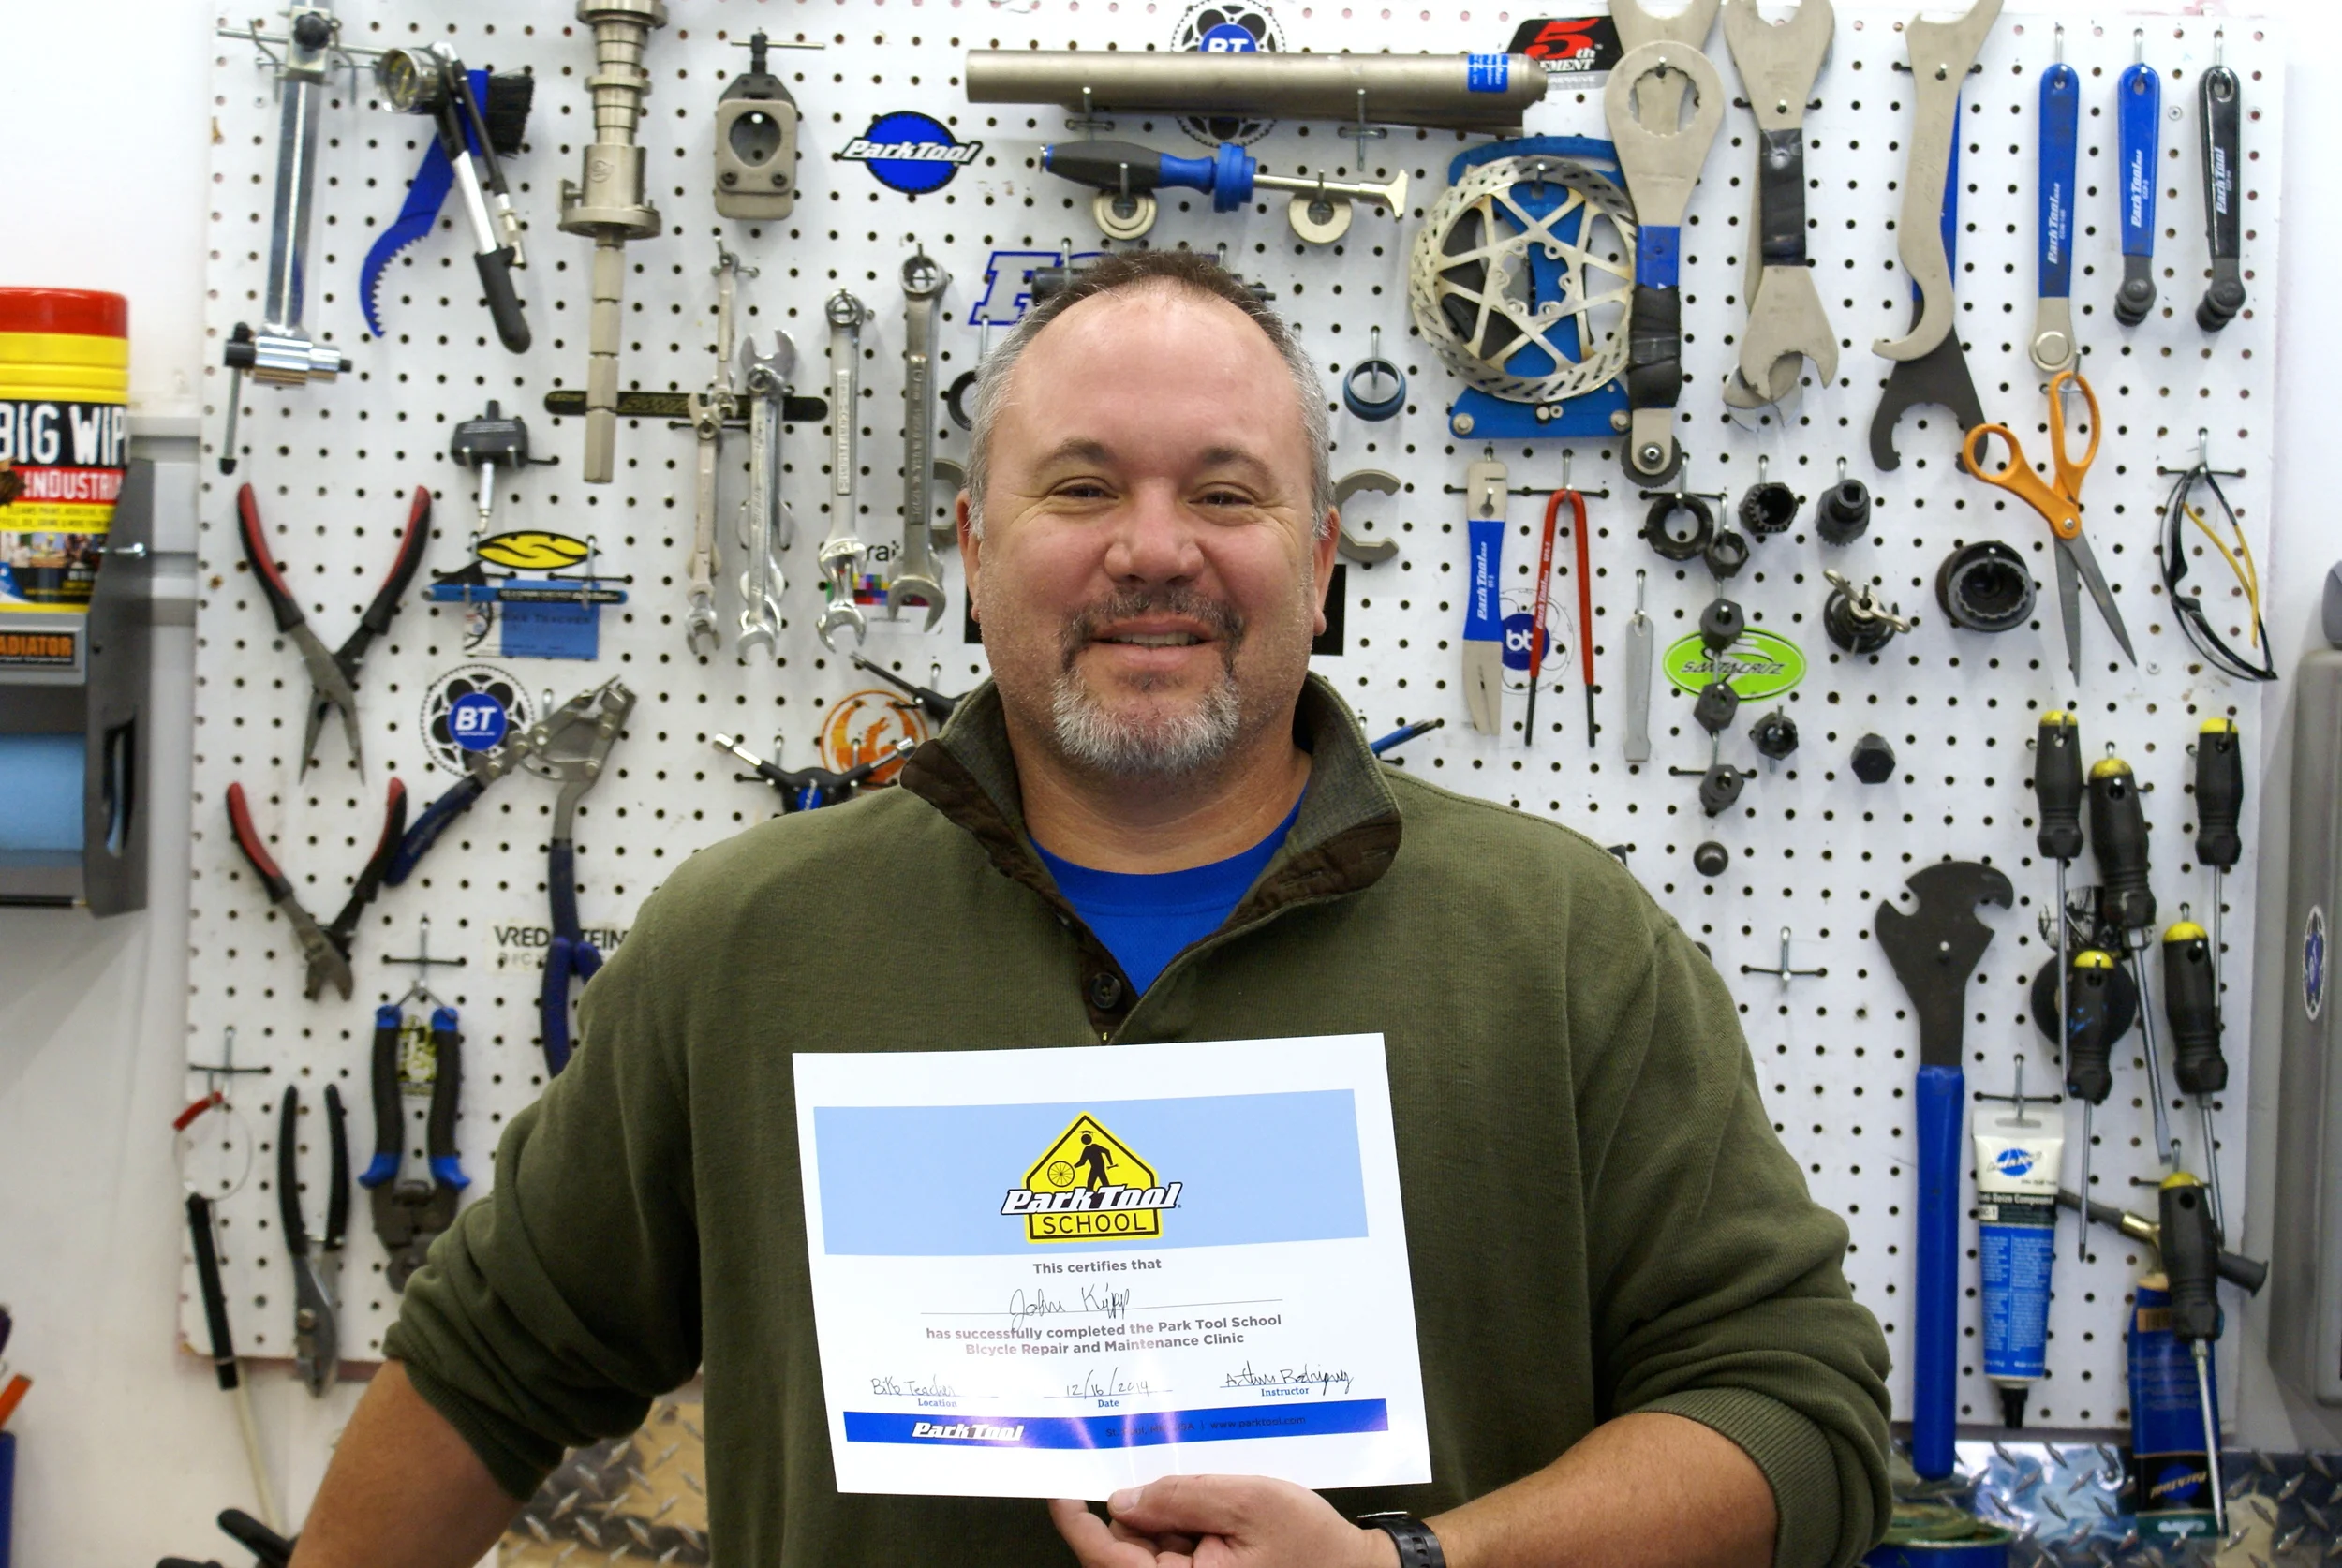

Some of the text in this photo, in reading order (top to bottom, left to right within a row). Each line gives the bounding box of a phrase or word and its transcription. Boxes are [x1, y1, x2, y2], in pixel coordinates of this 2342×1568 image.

[1540, 59, 1595, 71] EMENT
[0, 403, 130, 466] BIG WIP
[0, 635, 72, 658] ADIATOR
[455, 706, 497, 731] BT
[494, 925, 630, 950] VREDTEIN
[1043, 1213, 1147, 1235] SCHOOL
[1033, 1258, 1162, 1275] This certifies that
[1010, 1288, 1066, 1332] John
[926, 1314, 1282, 1340] has successfully completed the Park Tool School
[966, 1333, 1244, 1357] Bicycle Repair and Maintenance Clinic
[1261, 1386, 1310, 1397] Instructor
[918, 1398, 957, 1408] Location
[1098, 1398, 1119, 1408] Date
[1210, 1416, 1306, 1429] www.parktool.com
